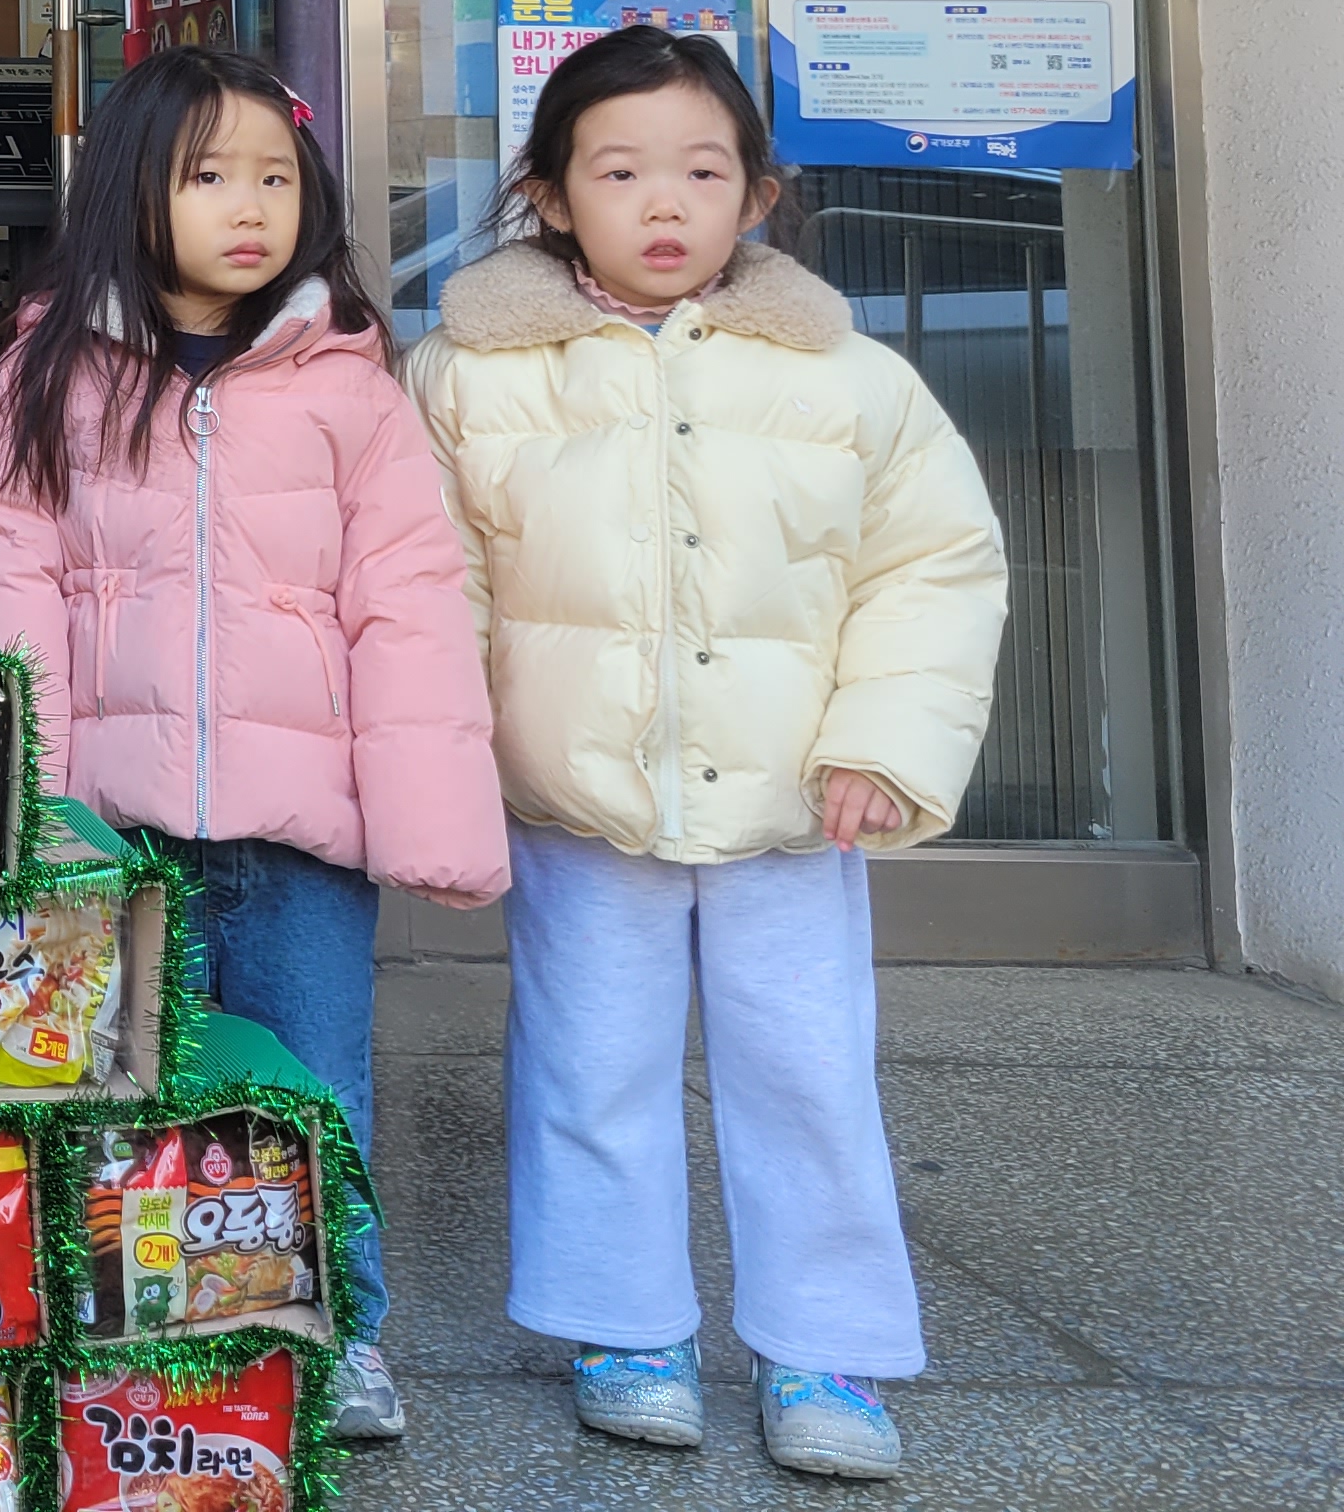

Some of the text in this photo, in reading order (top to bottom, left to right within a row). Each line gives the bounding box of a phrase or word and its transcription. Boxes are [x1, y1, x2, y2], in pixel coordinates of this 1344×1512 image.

[512, 31, 555, 51] 내가
[512, 55, 564, 75] 합니
[34, 1031, 68, 1061] 5개입
[139, 1195, 172, 1212] 완도산
[137, 1212, 170, 1230] 다시마
[142, 1240, 175, 1263] 2개!
[241, 1411, 269, 1421] KOREA
[83, 1404, 255, 1477] 김치라면
